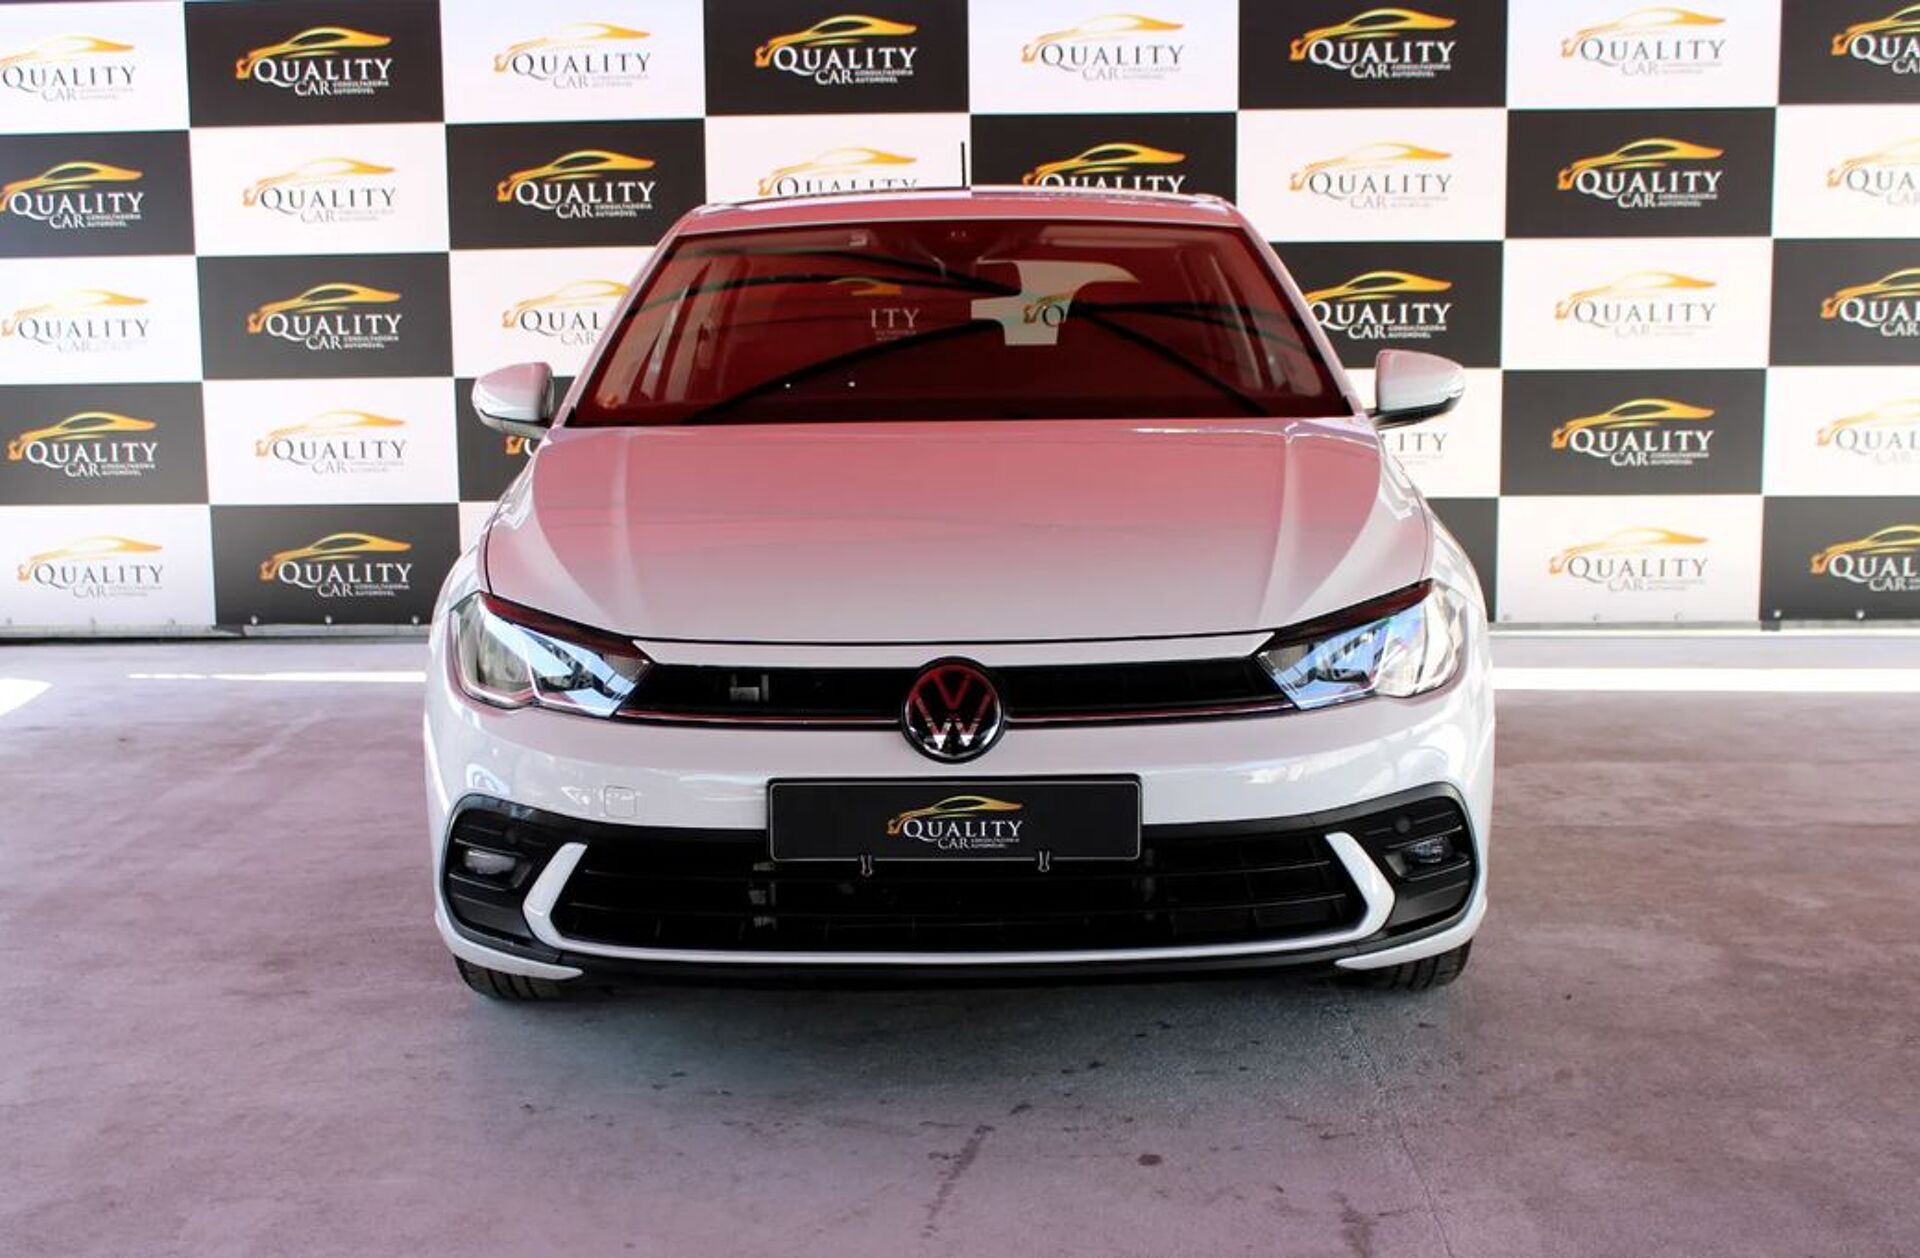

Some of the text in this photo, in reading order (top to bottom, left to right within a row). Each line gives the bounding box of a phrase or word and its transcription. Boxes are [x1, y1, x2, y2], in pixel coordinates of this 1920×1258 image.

[773, 46, 917, 74] QUALITY
[1041, 44, 1185, 72] QUALITY
[1308, 40, 1457, 68] QUALITY
[1579, 37, 1726, 66] QUALITY
[2, 65, 135, 92] QUALITY
[253, 59, 392, 84] QUALITY
[512, 53, 651, 79] QUALITY
[815, 69, 853, 85] CAR
[1082, 66, 1120, 81] CAR
[1351, 63, 1390, 79] CAR
[1892, 59, 1920, 74] CA
[295, 81, 332, 96] CAR
[553, 74, 589, 90] CAR
[514, 181, 656, 207] QUALITY
[1309, 171, 1453, 199] QUALITY
[1576, 168, 1723, 198] QUALITY
[9, 192, 144, 218] QUALITY
[260, 187, 396, 212] QUALITY
[556, 204, 594, 219] CAR
[1618, 193, 1656, 208] CAR
[50, 214, 86, 229] CAR
[266, 313, 402, 338] QUALITY
[1308, 302, 1452, 331] QUALITY
[1574, 301, 1716, 328] QUALITY
[17, 318, 150, 344] QUALITY
[306, 335, 342, 349] CAR
[1348, 325, 1386, 339] CAR
[25, 441, 158, 466] QUALITY
[273, 439, 407, 464] QUALITY
[1569, 428, 1715, 457] QUALITY
[65, 463, 100, 477] CAR
[1611, 452, 1648, 466] CAR
[34, 564, 163, 590] QUALITY
[277, 561, 413, 588] QUALITY
[1567, 556, 1708, 584] QUALITY
[317, 582, 353, 597] CAR
[1869, 577, 1907, 592] CAR
[903, 819, 1023, 842] QUALITY
[938, 838, 970, 849] CAR
